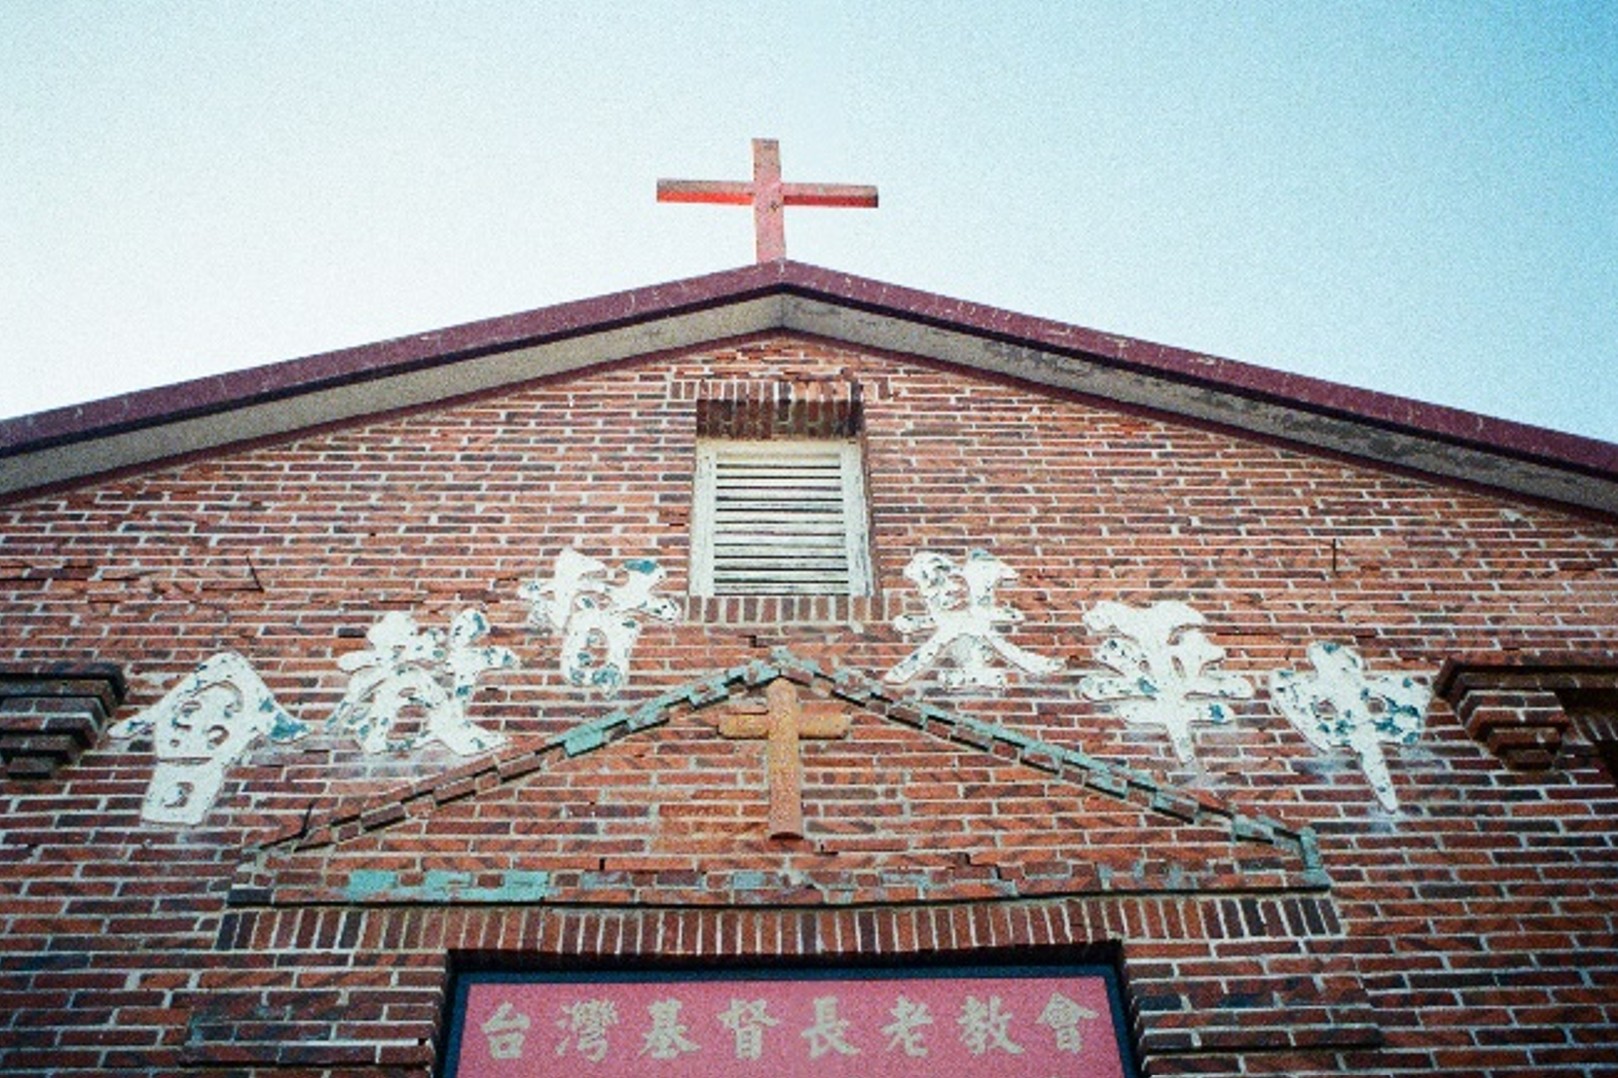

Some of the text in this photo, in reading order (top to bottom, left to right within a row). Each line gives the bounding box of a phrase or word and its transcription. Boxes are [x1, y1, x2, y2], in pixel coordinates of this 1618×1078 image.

[480, 991, 1099, 1062] 台灣基督長老教會
